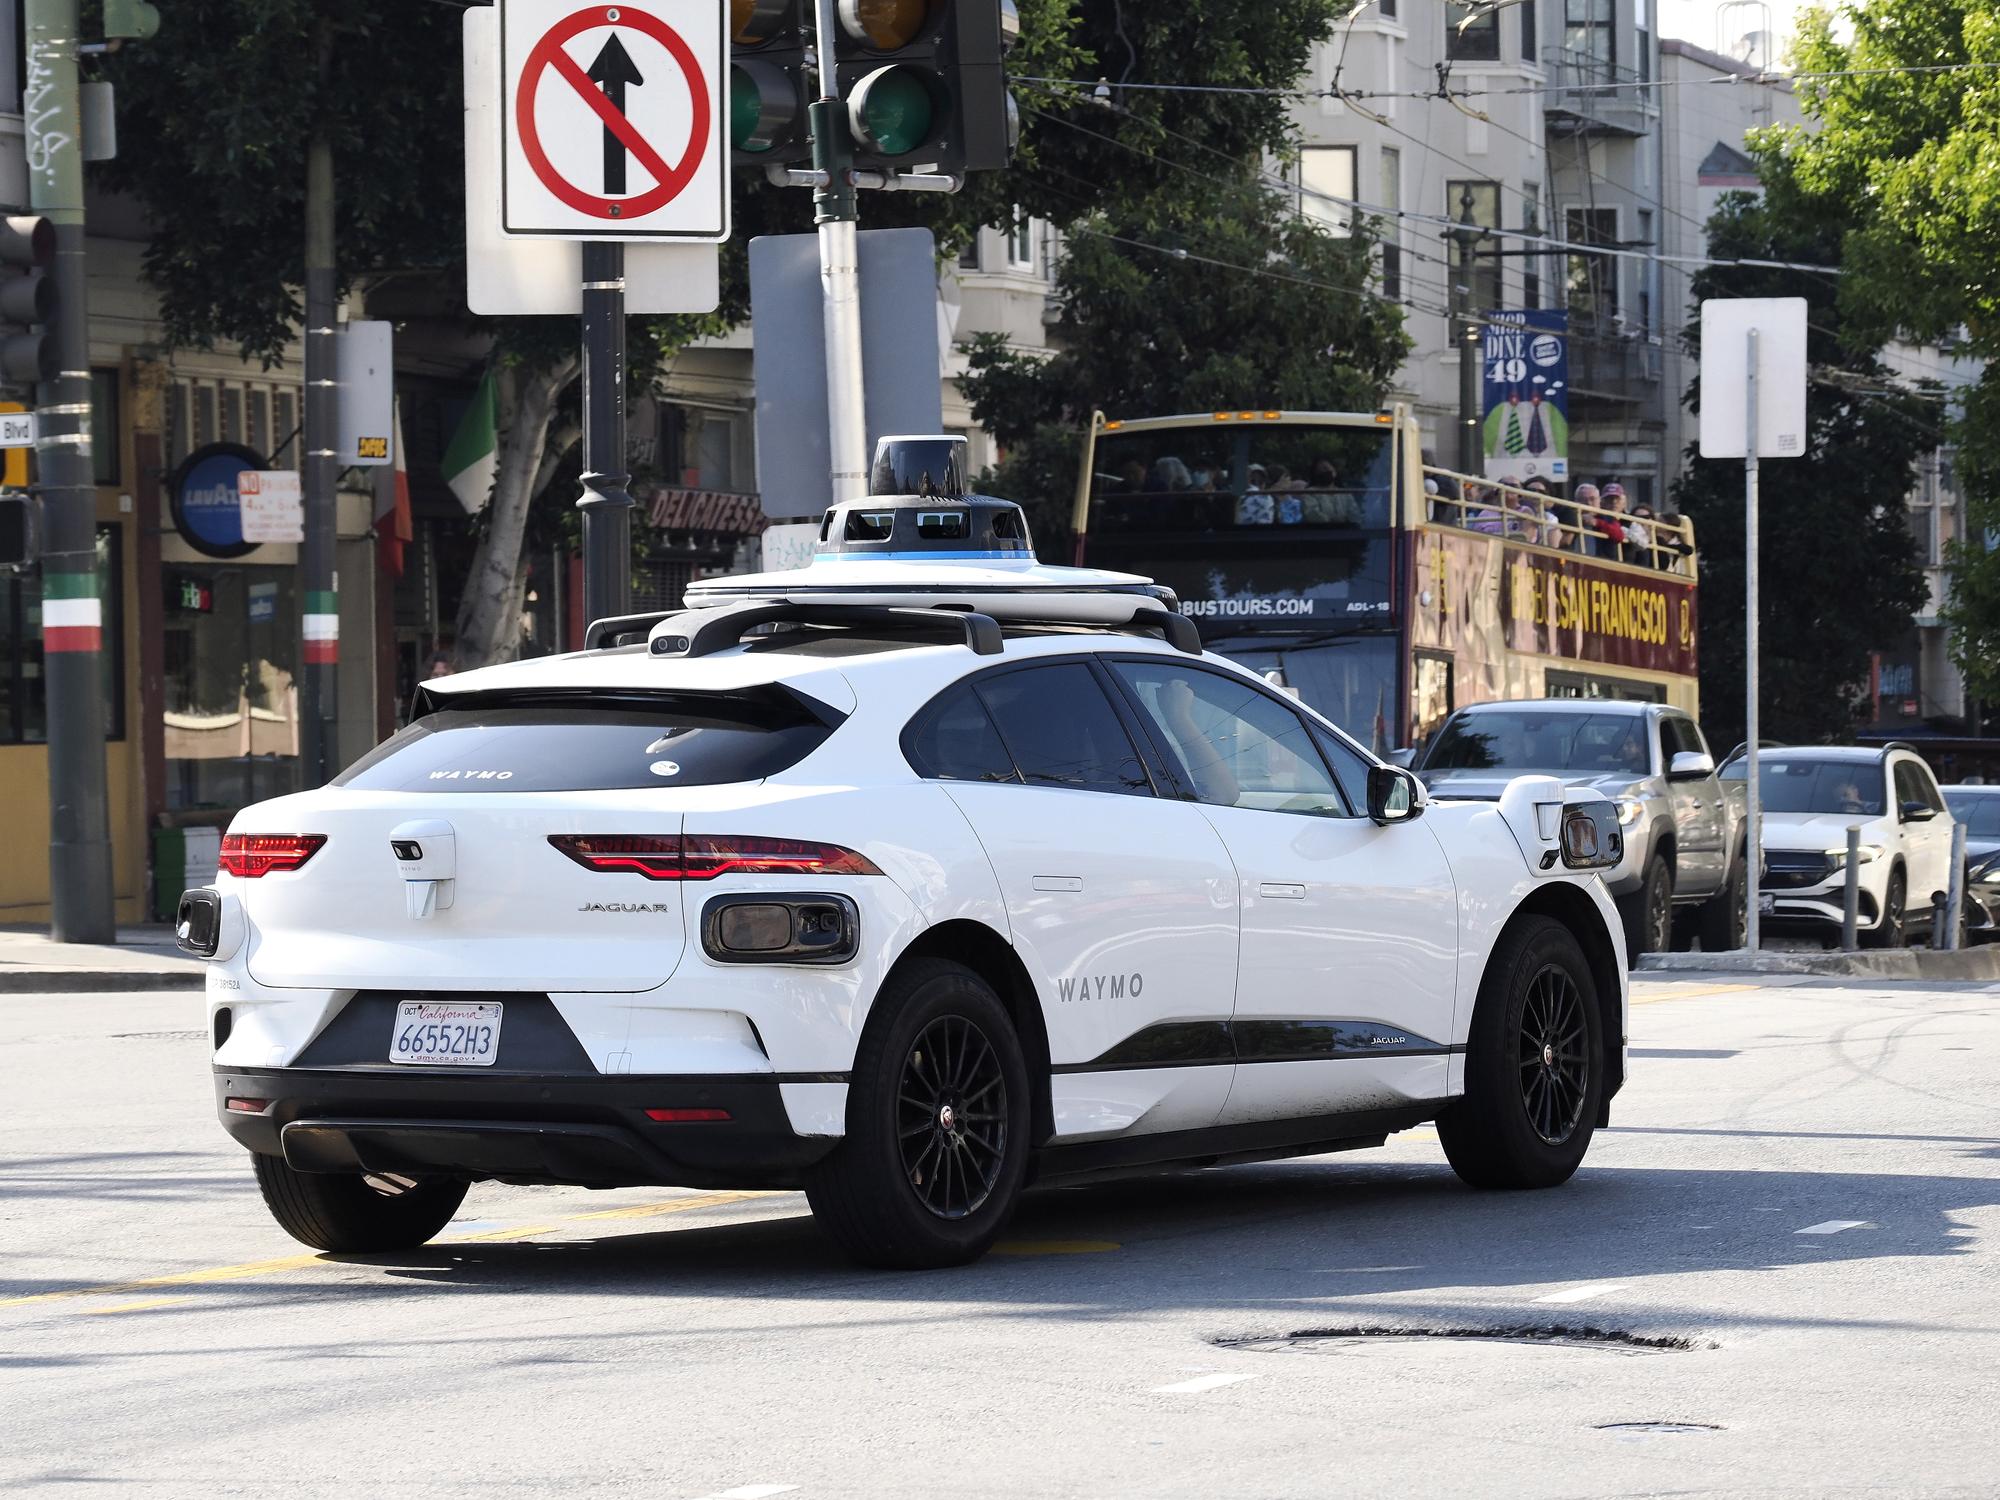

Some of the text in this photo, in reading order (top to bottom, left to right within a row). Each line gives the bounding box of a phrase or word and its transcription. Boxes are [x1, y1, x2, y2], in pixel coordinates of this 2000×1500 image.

[1487, 335, 1525, 359] DINE
[1486, 359, 1527, 383] 49
[4, 421, 29, 439] Blvd
[649, 489, 768, 535] DELICATESSE
[1178, 599, 1313, 616] BUSTOURS.COM
[1560, 574, 1589, 632] SAN
[1591, 580, 1667, 645] FRANCISCO
[429, 770, 513, 780] WAYMO
[578, 902, 668, 913] JAGUAR
[1058, 973, 1143, 1003] WAYMO
[405, 1007, 417, 1016] OCT
[419, 1005, 482, 1024] California
[398, 1024, 492, 1055] 66552H3
[1370, 1036, 1406, 1045] JAGUAR
